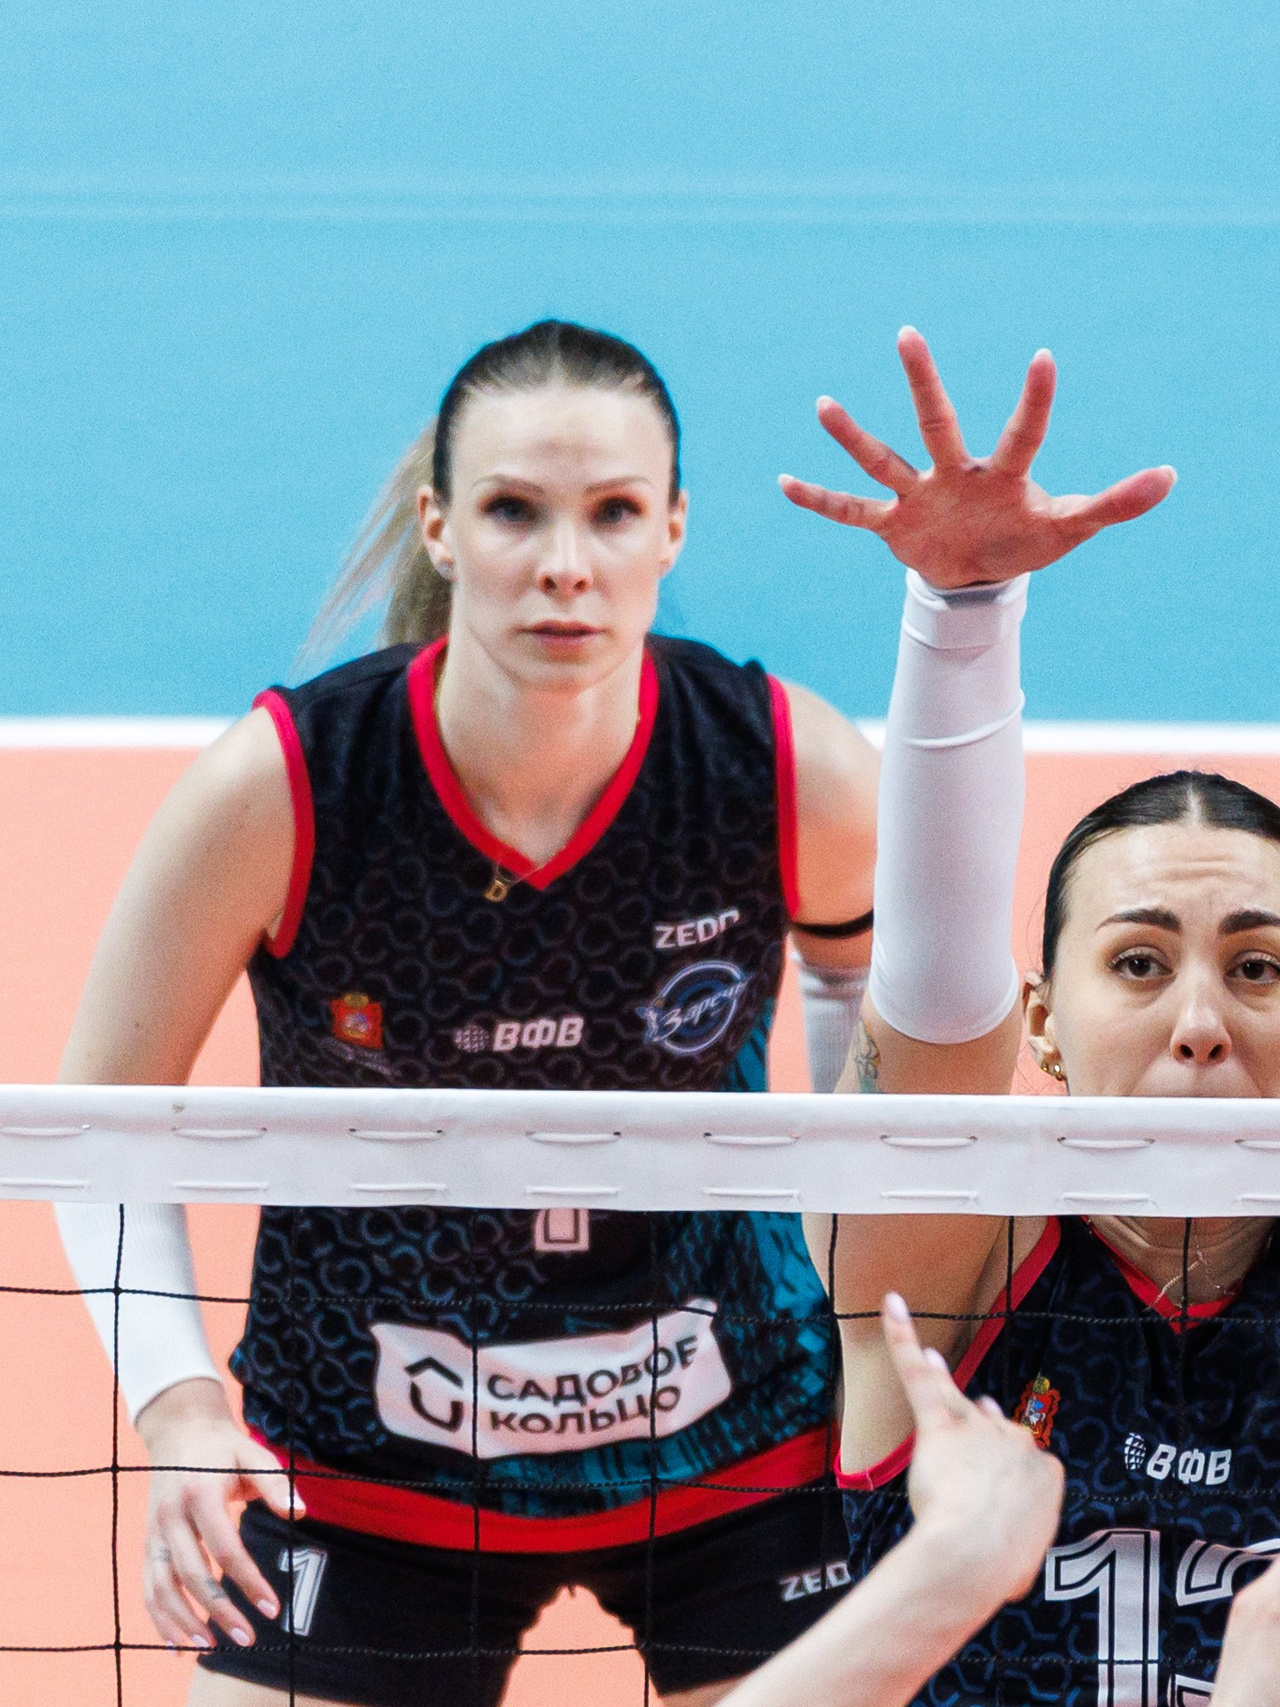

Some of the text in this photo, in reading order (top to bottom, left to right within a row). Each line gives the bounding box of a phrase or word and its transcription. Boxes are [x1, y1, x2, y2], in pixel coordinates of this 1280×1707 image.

[493, 1014, 585, 1051] ВФВ
[487, 1335, 699, 1407] САДОВОЕ
[490, 1386, 681, 1435] КОЛЬЦО
[1146, 1443, 1232, 1486] ВФВ
[279, 1548, 328, 1637] 1
[779, 1562, 852, 1602] ZED
